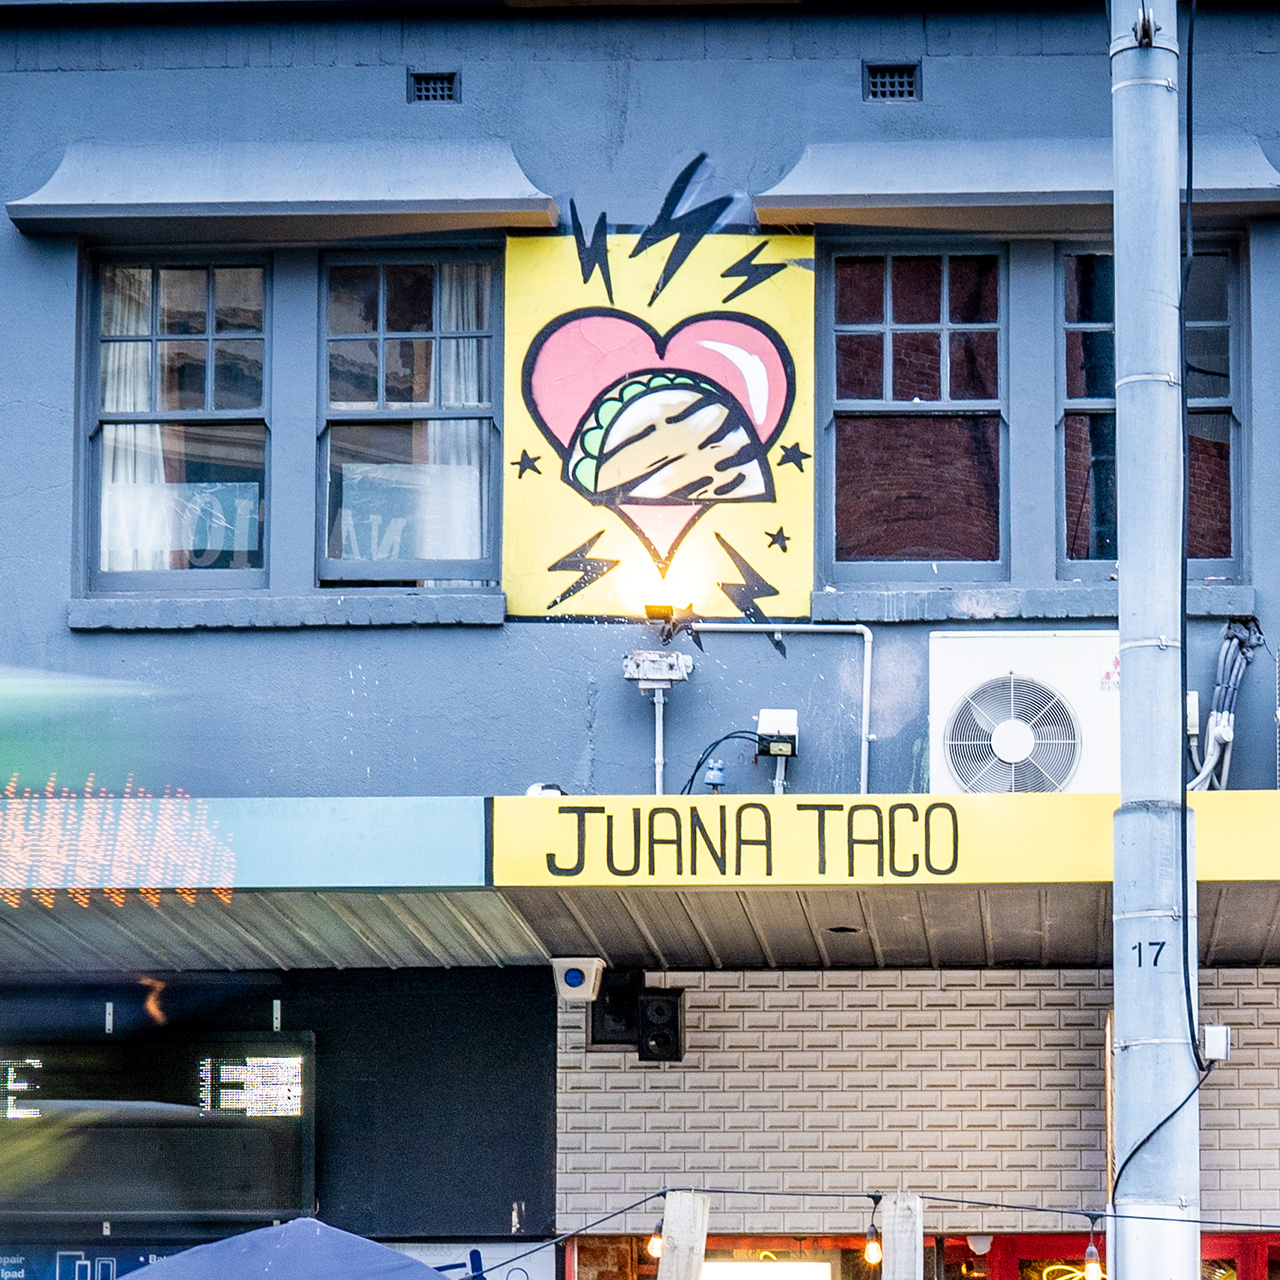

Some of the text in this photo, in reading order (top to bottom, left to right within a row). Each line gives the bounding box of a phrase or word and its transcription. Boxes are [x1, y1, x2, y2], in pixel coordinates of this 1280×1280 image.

[545, 801, 959, 878] JUANA TACO
[1131, 941, 1166, 968] 17
[0, 1269, 25, 1280] Ipad
